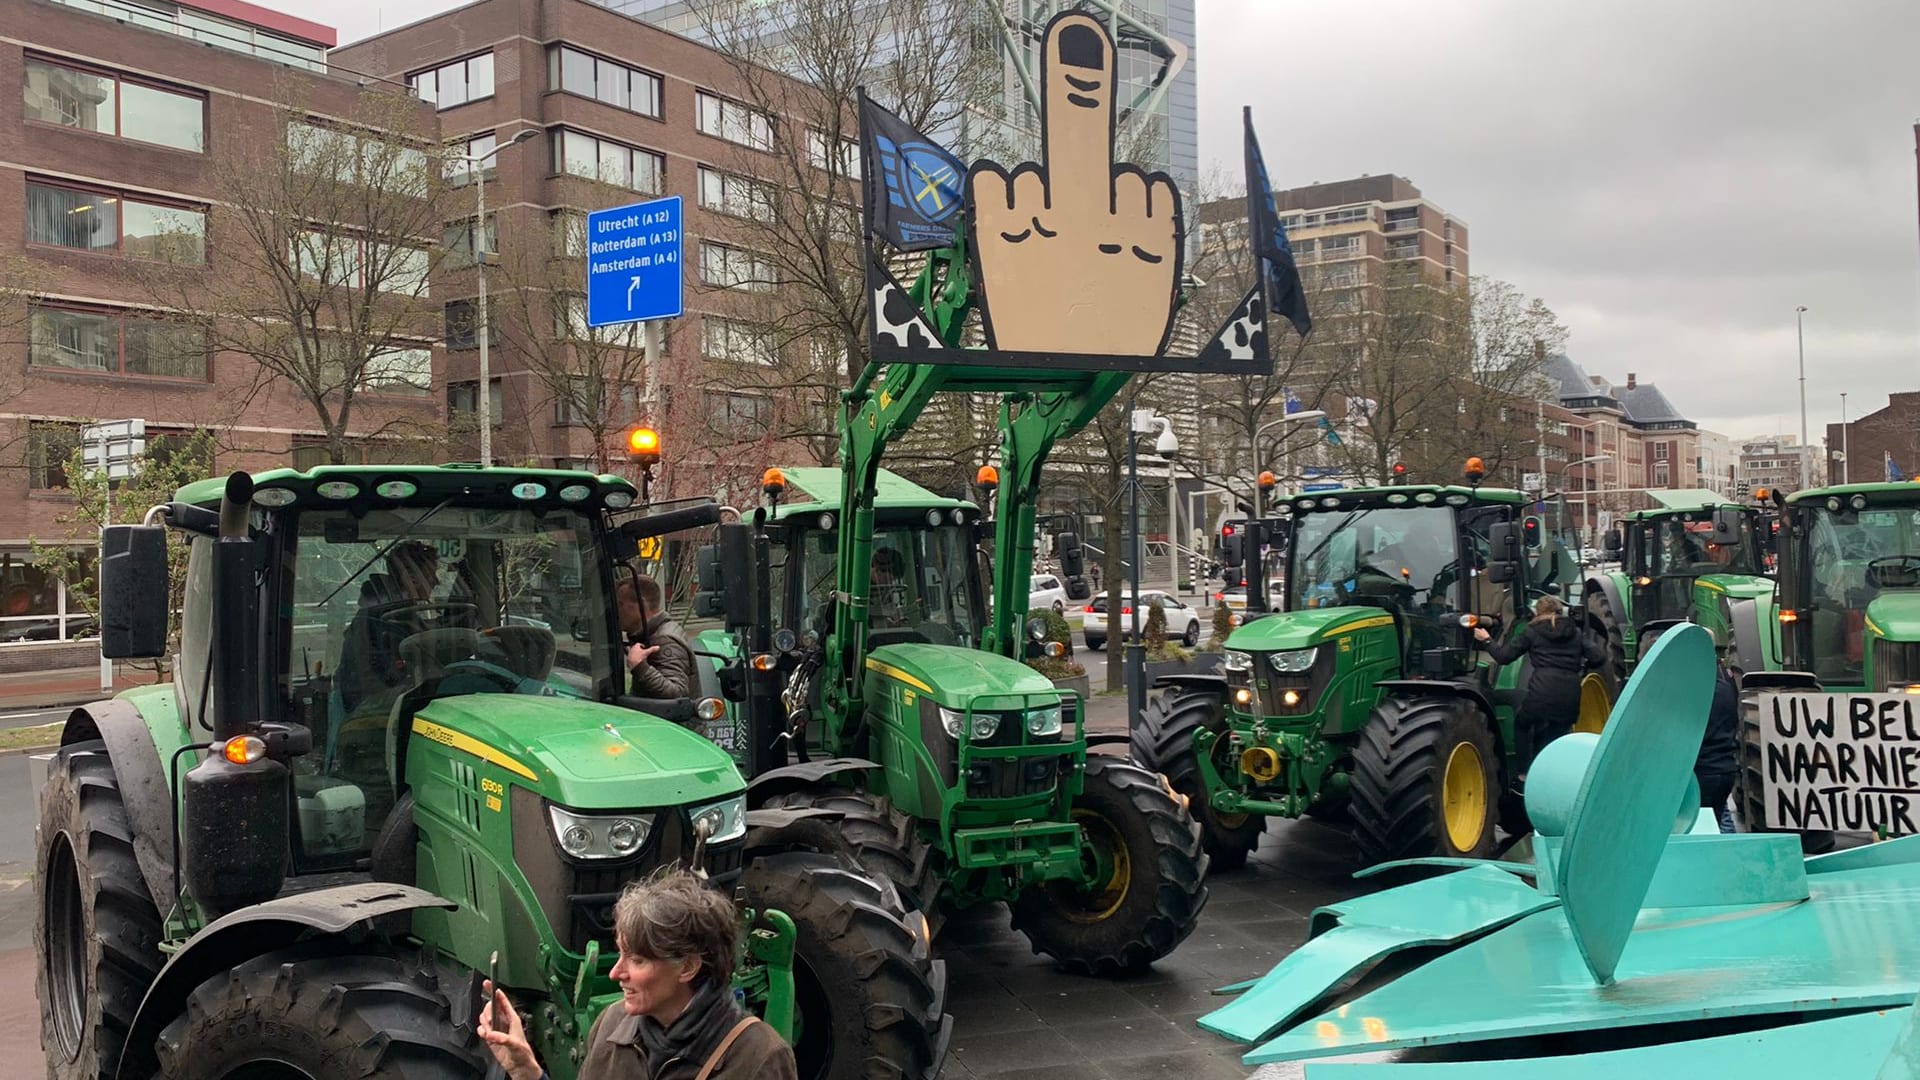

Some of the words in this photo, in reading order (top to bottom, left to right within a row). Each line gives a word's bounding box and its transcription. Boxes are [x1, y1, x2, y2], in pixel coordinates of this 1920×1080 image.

[598, 215, 639, 233] Utrecht
[591, 236, 647, 255] Rotterdam
[591, 256, 651, 275] Amsterdam
[1772, 696, 1834, 739] UW
[1850, 697, 1920, 741] BEL
[1767, 742, 1859, 784] NAAR
[1863, 743, 1920, 787] NIE
[1777, 786, 1918, 833] NATUUR
